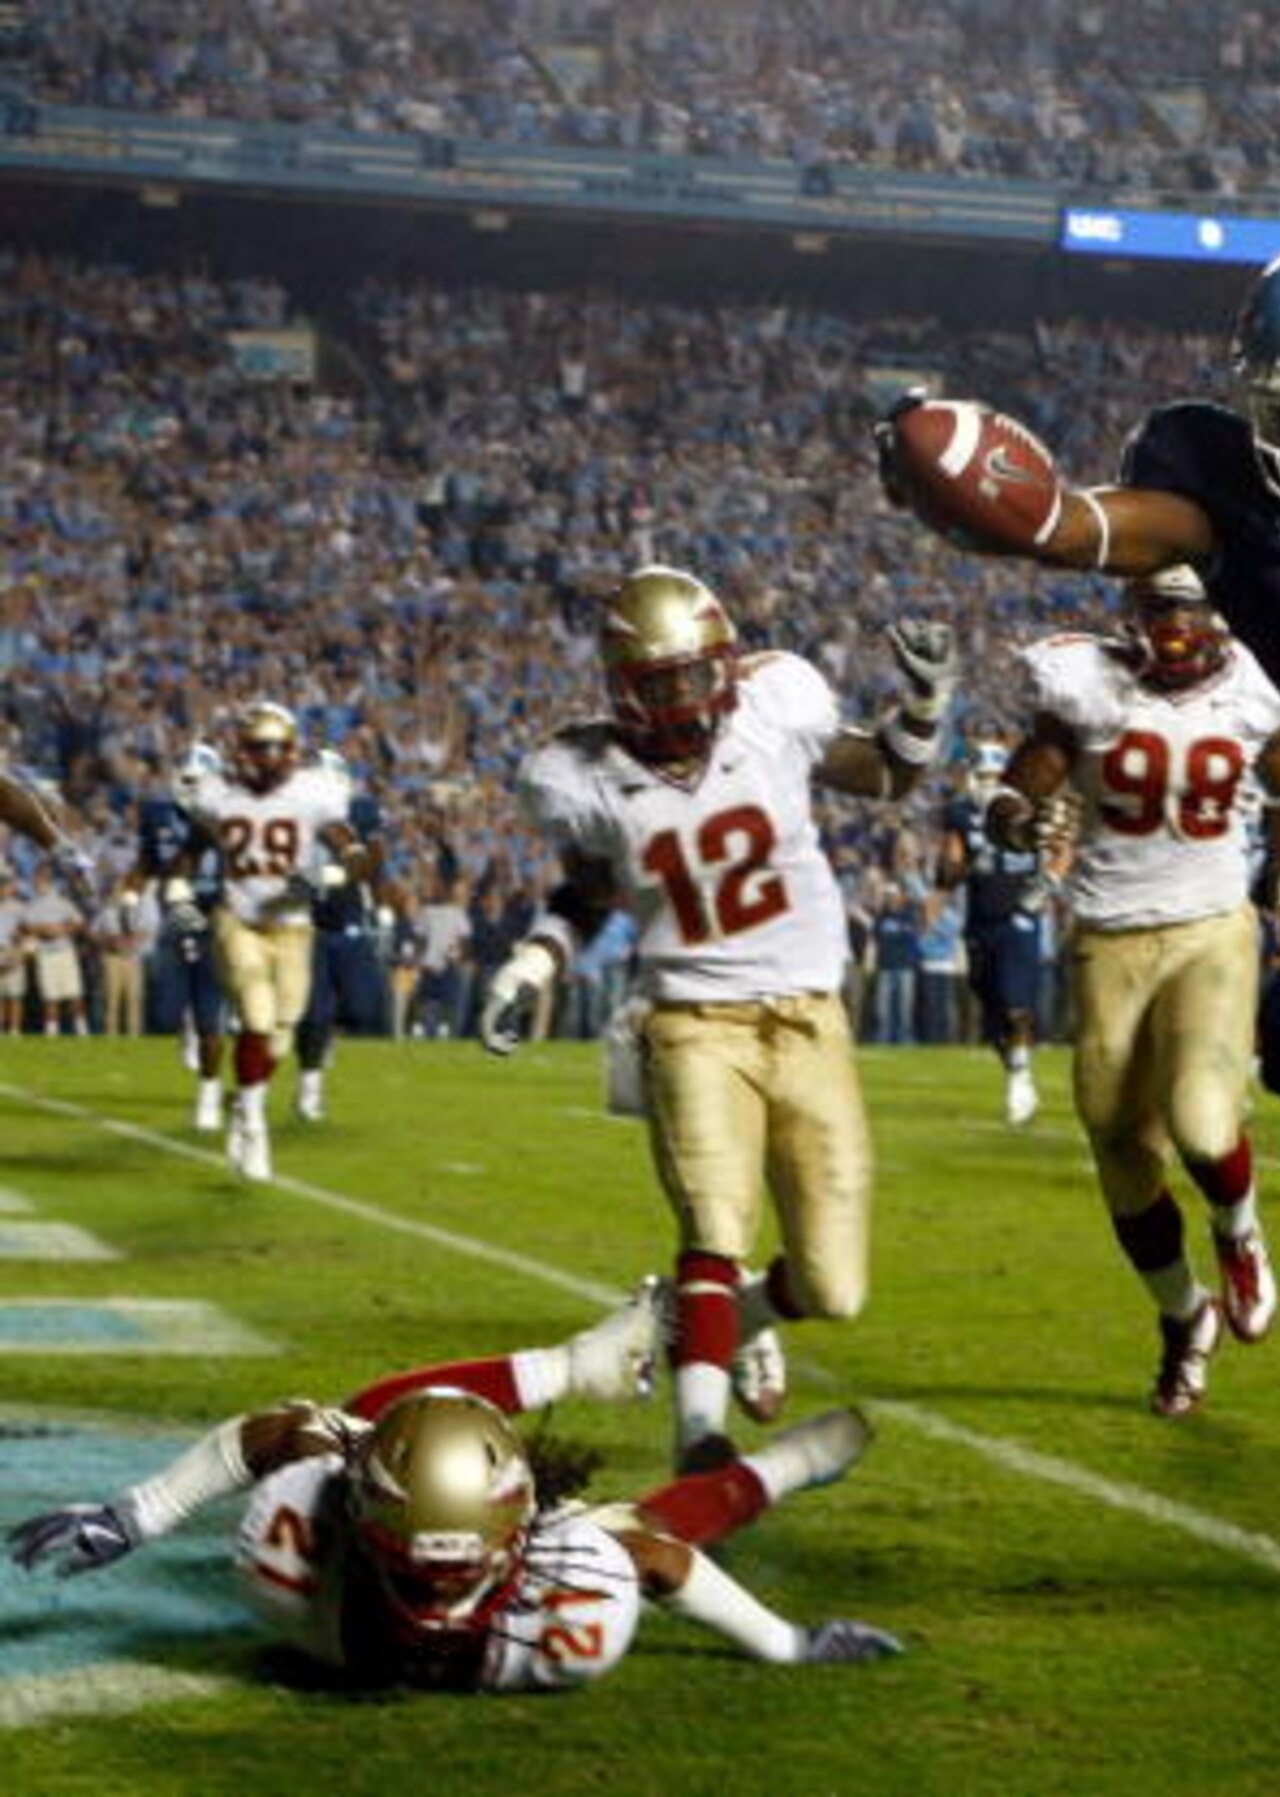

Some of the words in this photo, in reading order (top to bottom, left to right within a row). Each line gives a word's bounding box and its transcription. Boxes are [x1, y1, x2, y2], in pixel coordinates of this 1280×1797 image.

[1102, 728, 1245, 839] 98
[219, 817, 299, 879] 29
[641, 803, 792, 946] 12
[540, 1588, 606, 1663] 21
